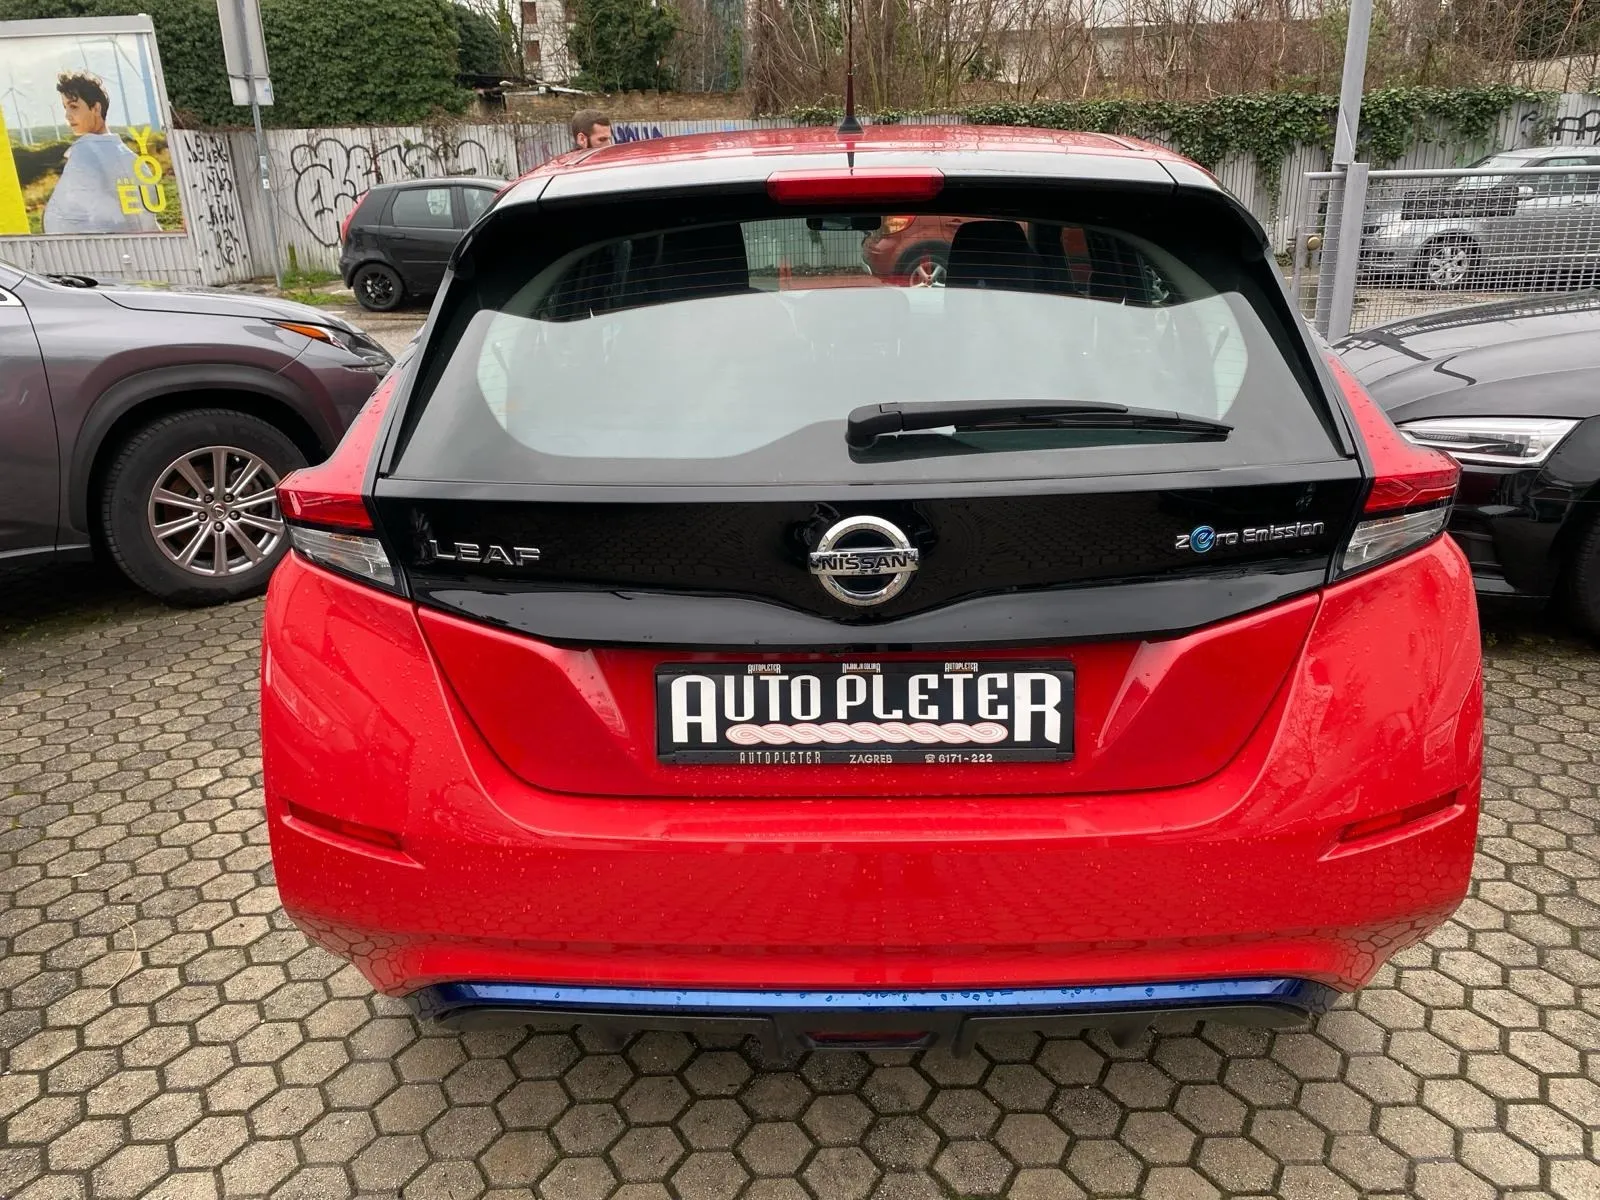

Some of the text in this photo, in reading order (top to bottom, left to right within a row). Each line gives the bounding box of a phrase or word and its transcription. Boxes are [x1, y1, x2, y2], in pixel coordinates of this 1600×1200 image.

[1242, 522, 1324, 543] Emission
[429, 539, 541, 566] LEAF
[821, 555, 908, 570] NISSAN
[747, 663, 781, 675] AUTOPLETER
[739, 751, 821, 764] AUTOPLETER
[849, 754, 893, 764] ZAGREB
